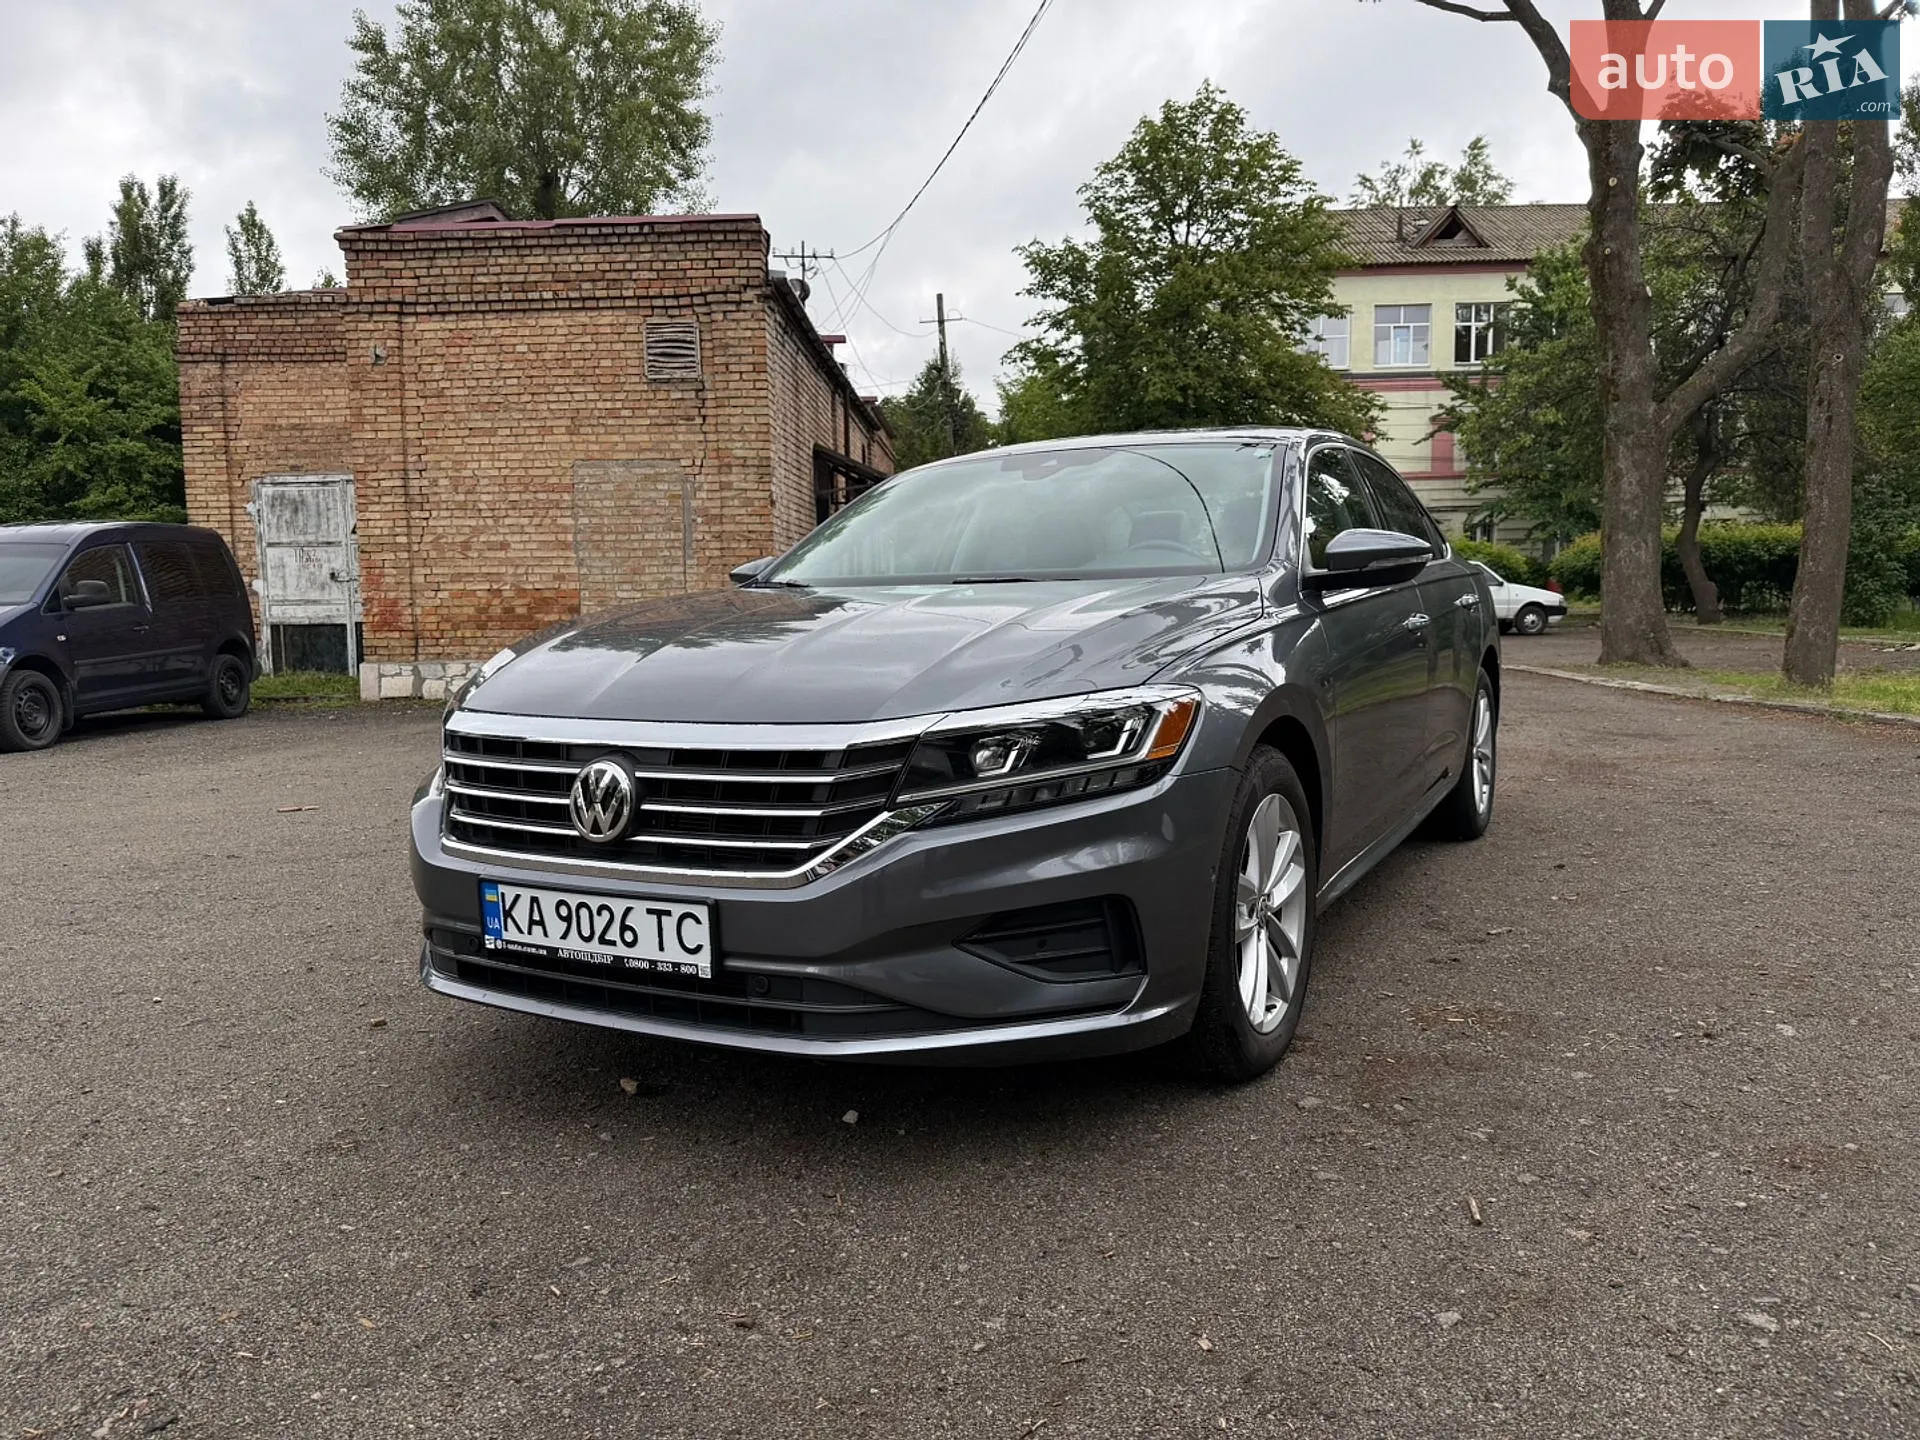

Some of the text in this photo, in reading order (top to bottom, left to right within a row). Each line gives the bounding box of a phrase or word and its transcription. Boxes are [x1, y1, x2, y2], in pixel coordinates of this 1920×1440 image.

[486, 916, 500, 929] UA
[500, 891, 704, 955] KA 9026 TC
